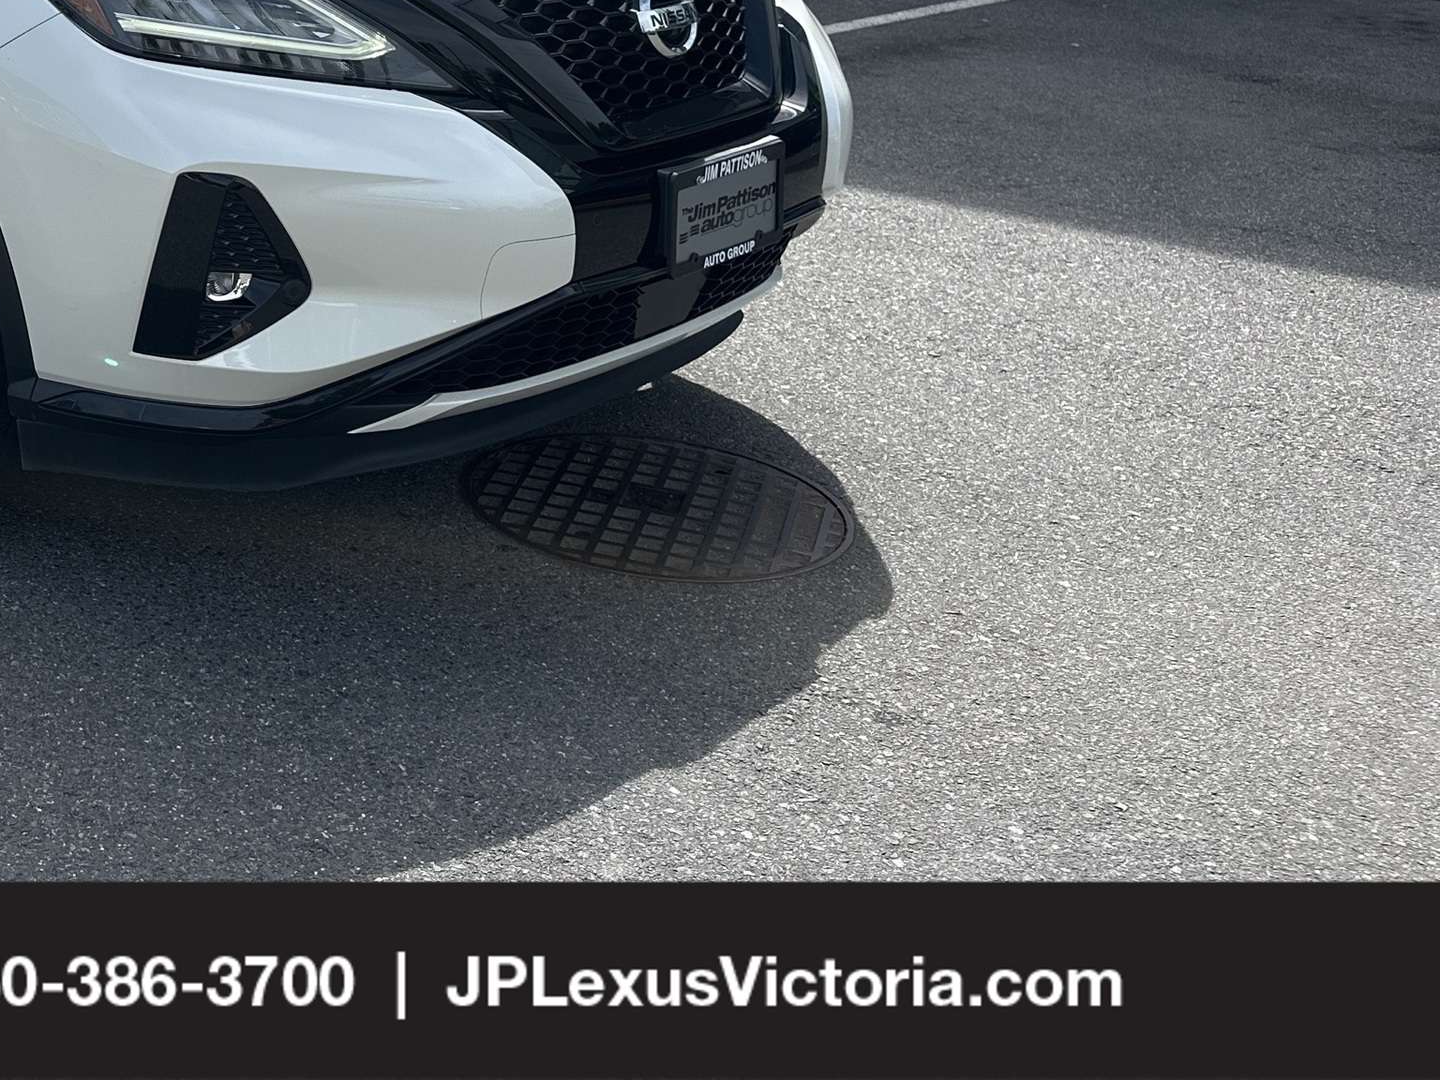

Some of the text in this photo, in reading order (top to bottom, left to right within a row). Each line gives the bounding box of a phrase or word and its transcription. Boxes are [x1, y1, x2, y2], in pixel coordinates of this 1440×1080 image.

[701, 149, 763, 183] JIM PATTISON
[703, 240, 756, 269] AUTO GROUP
